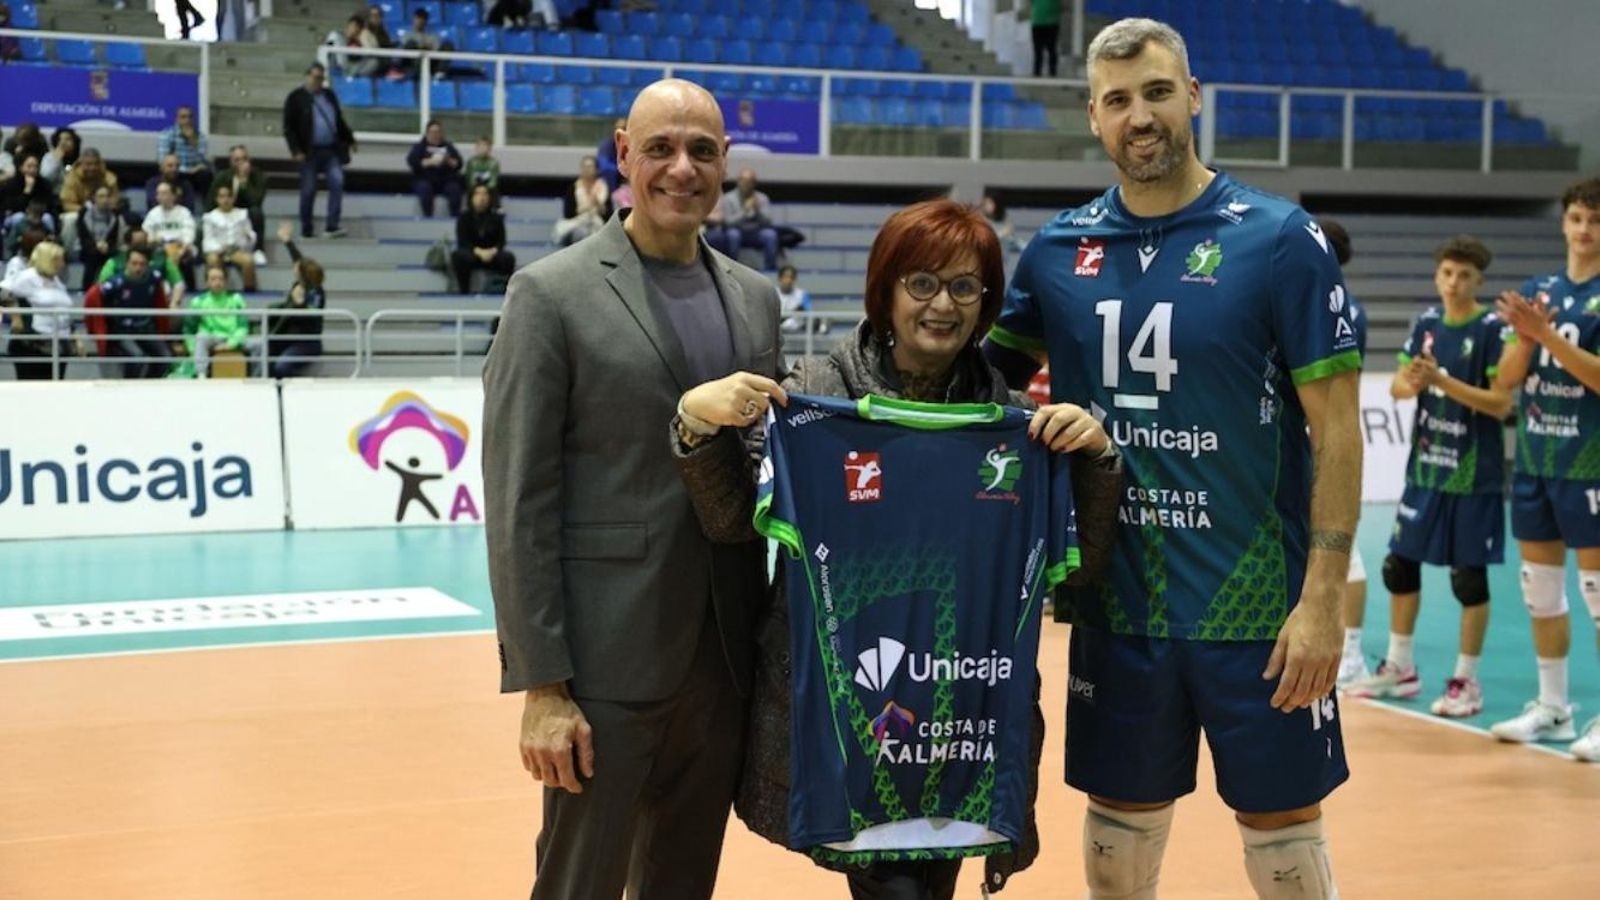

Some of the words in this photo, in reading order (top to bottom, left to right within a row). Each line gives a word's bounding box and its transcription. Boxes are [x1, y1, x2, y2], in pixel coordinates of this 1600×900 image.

[31, 101, 99, 114] DIPUTACIÓN
[102, 105, 116, 116] DE
[118, 105, 166, 119] ALMERÍA
[1095, 300, 1178, 392] 14
[1113, 421, 1218, 459] Unicaja
[0, 440, 253, 518] nicaja
[849, 488, 880, 501] SVM
[1127, 486, 1181, 505] COSTA
[1185, 490, 1208, 506] DE
[1118, 506, 1212, 529] ALMERÍA
[908, 650, 1013, 687] Unicaja
[919, 719, 974, 738] COSTA
[978, 718, 997, 735] DE
[898, 737, 996, 764] ALMERÍA
